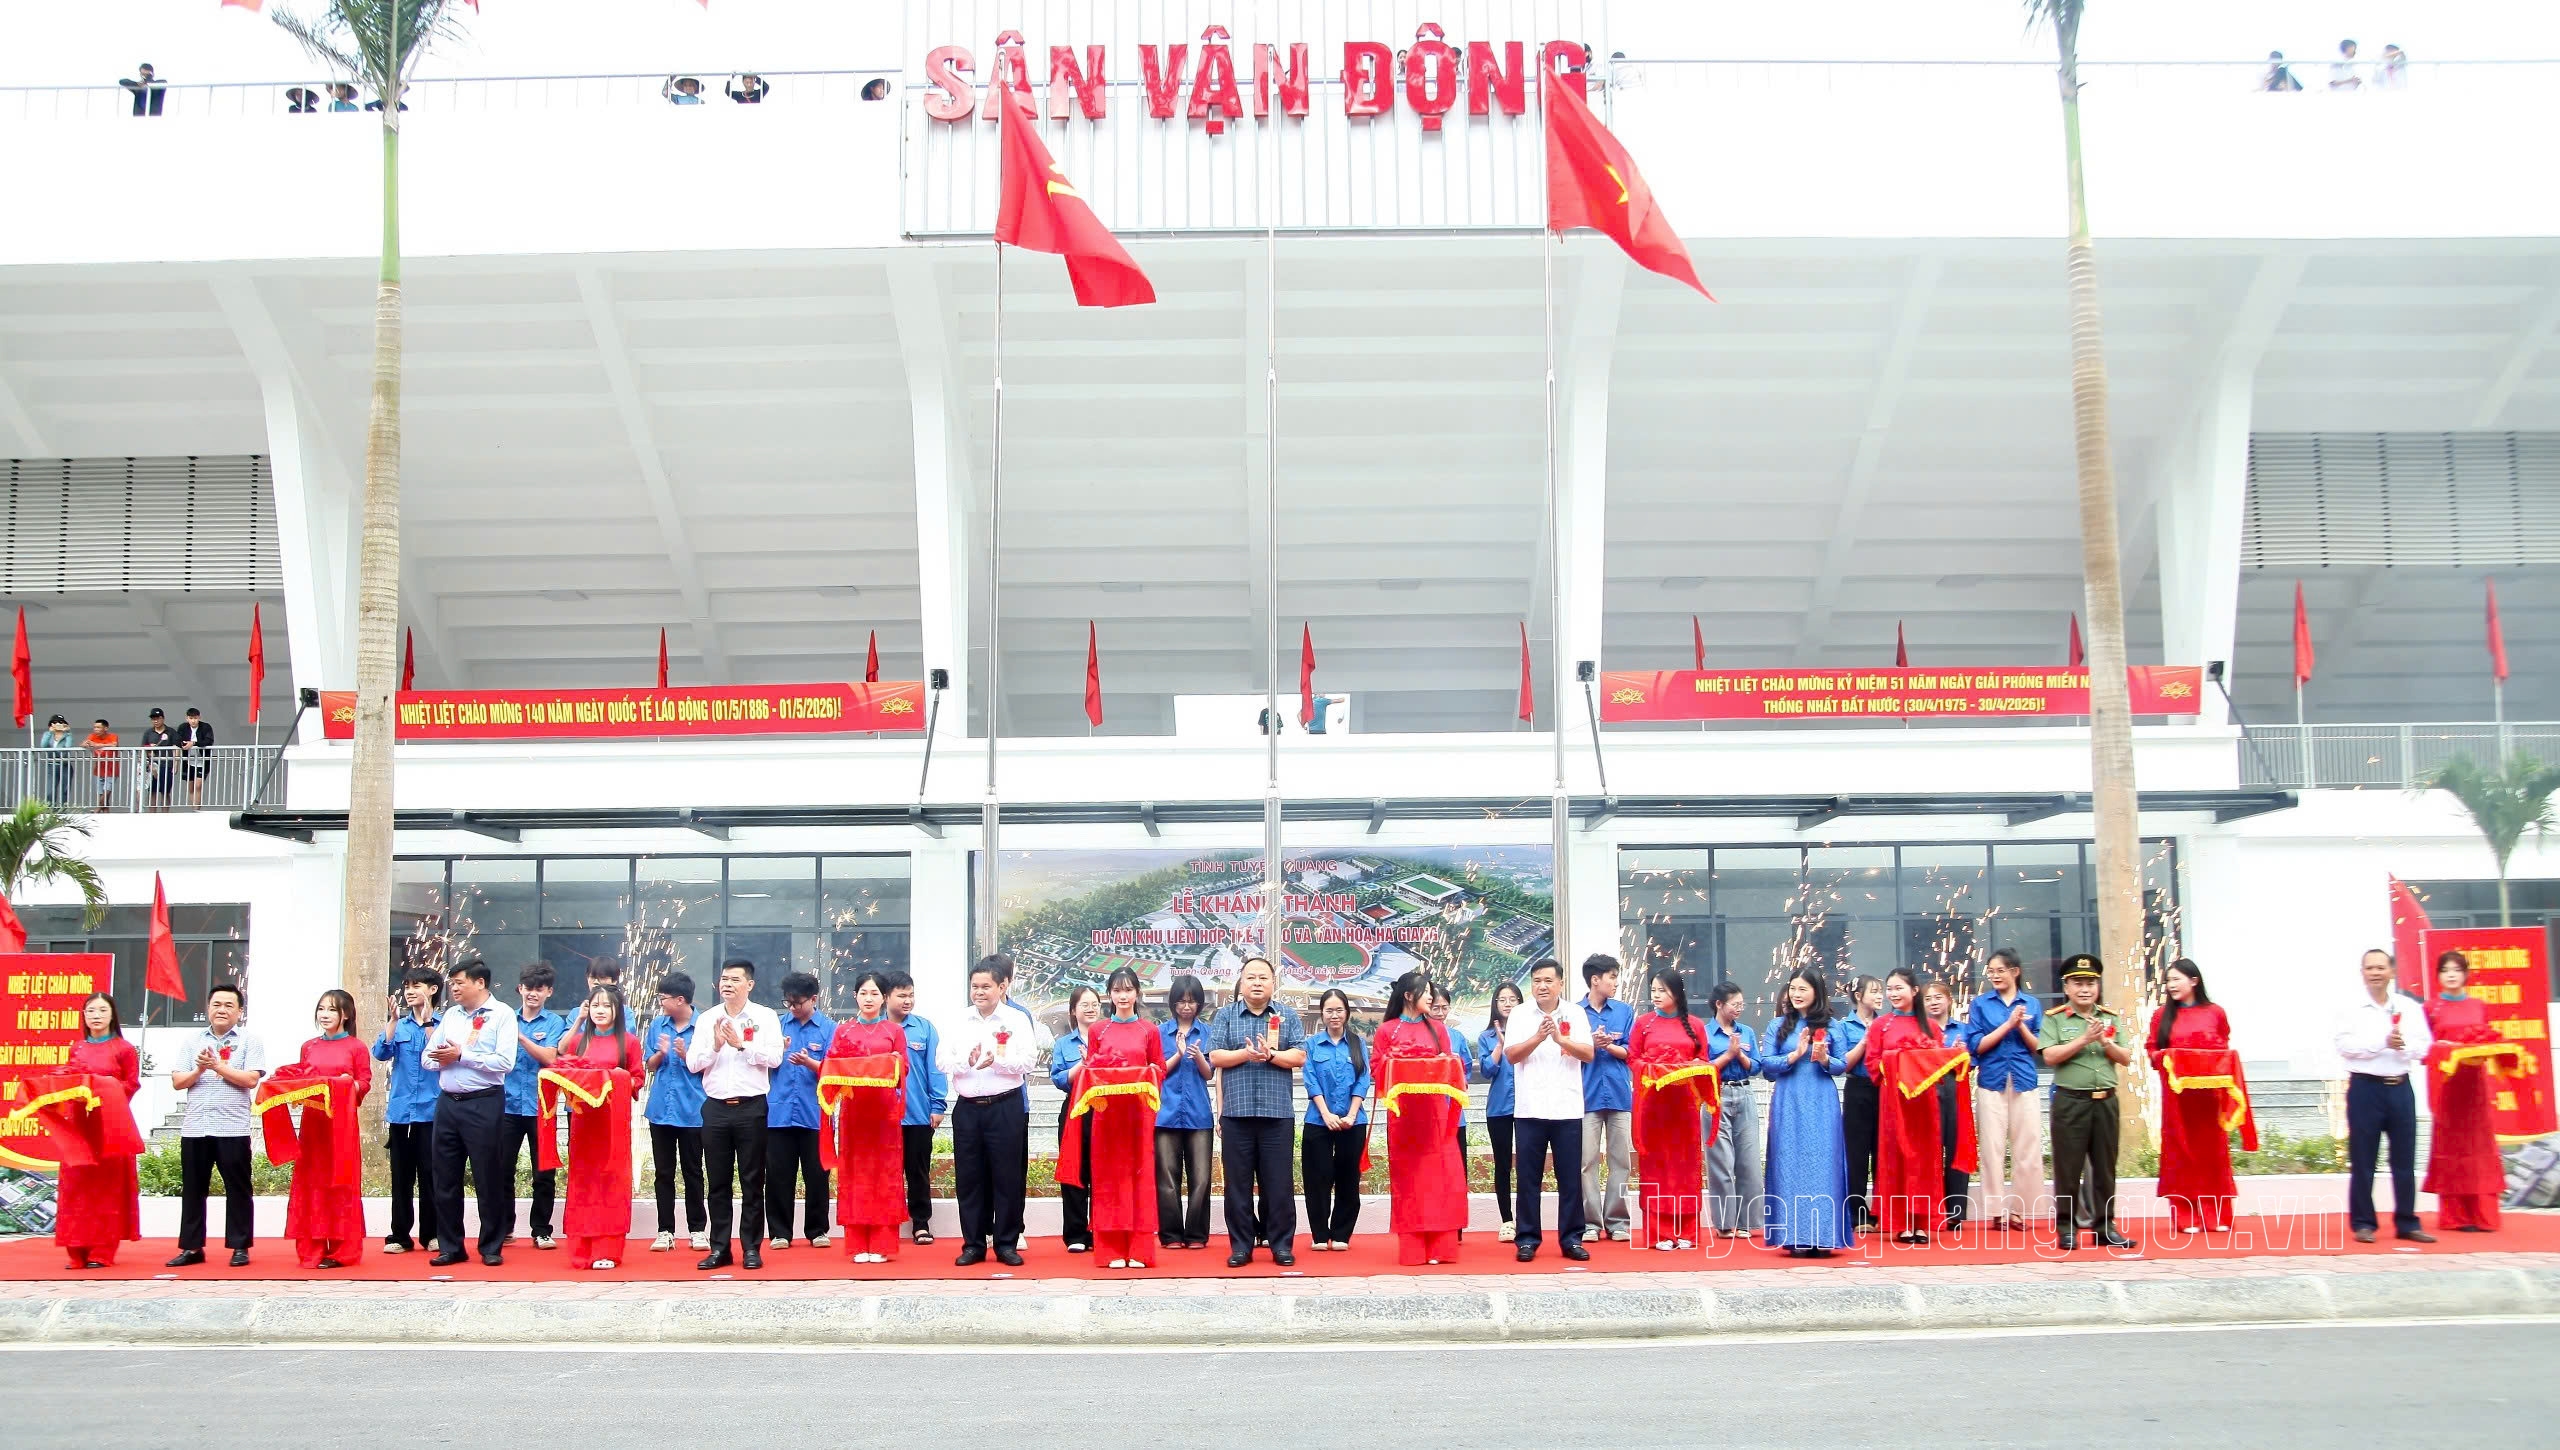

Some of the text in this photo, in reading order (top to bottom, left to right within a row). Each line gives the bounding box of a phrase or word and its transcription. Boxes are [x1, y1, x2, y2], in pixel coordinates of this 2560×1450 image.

[924, 22, 1588, 134] SÂN VẬN ĐỘNG
[1695, 676, 1730, 695] NHIỆT
[1734, 675, 1758, 694] LIỆT
[1761, 675, 1794, 691] CHÀO
[1797, 675, 1834, 691] MỪNG
[1856, 675, 1887, 694] NIỆM
[1891, 677, 1904, 690] 51
[1908, 674, 1937, 689] NĂM
[1940, 672, 1972, 689] NGÀY
[1975, 672, 1999, 689] GIẢI
[2002, 672, 2043, 689] PHÓNG
[400, 700, 431, 729] NHIỆT
[434, 699, 455, 728] LIỆT
[458, 700, 487, 725] CHÀO
[489, 699, 523, 724] MỪNG
[525, 703, 545, 724] 140
[547, 699, 573, 723] NĂM
[575, 698, 604, 723] NGÀY
[608, 694, 637, 724] QUỐC
[639, 695, 653, 722] TẾ
[678, 696, 708, 725] ĐỘNG
[711, 699, 769, 723] (01/5/1886
[779, 697, 842, 720] 01/5/2026)!
[1763, 695, 1803, 713] THỐNG
[1807, 695, 1838, 712] NHẤT
[1841, 694, 1865, 712] ĐẤT
[1867, 696, 1900, 712] NƯỚC
[1904, 698, 1967, 713] (30/4/1975
[1978, 697, 2046, 711] 30/4/2026)!
[1229, 858, 1266, 873] TUYÊ
[1283, 859, 1338, 873] QUANG
[1172, 887, 1357, 914] LỄ KHÁN THÀNH
[1092, 928, 1111, 947] DỰ
[1113, 926, 1132, 945] ÁN
[1136, 929, 1162, 945] KHU
[1166, 927, 1196, 945] LIÊN
[1200, 927, 1227, 948] HỢP
[1294, 925, 1313, 944] VÀ
[1344, 924, 1374, 943] HÓA
[1376, 924, 1395, 942] HÀ
[50, 1010, 59, 1029] 51
